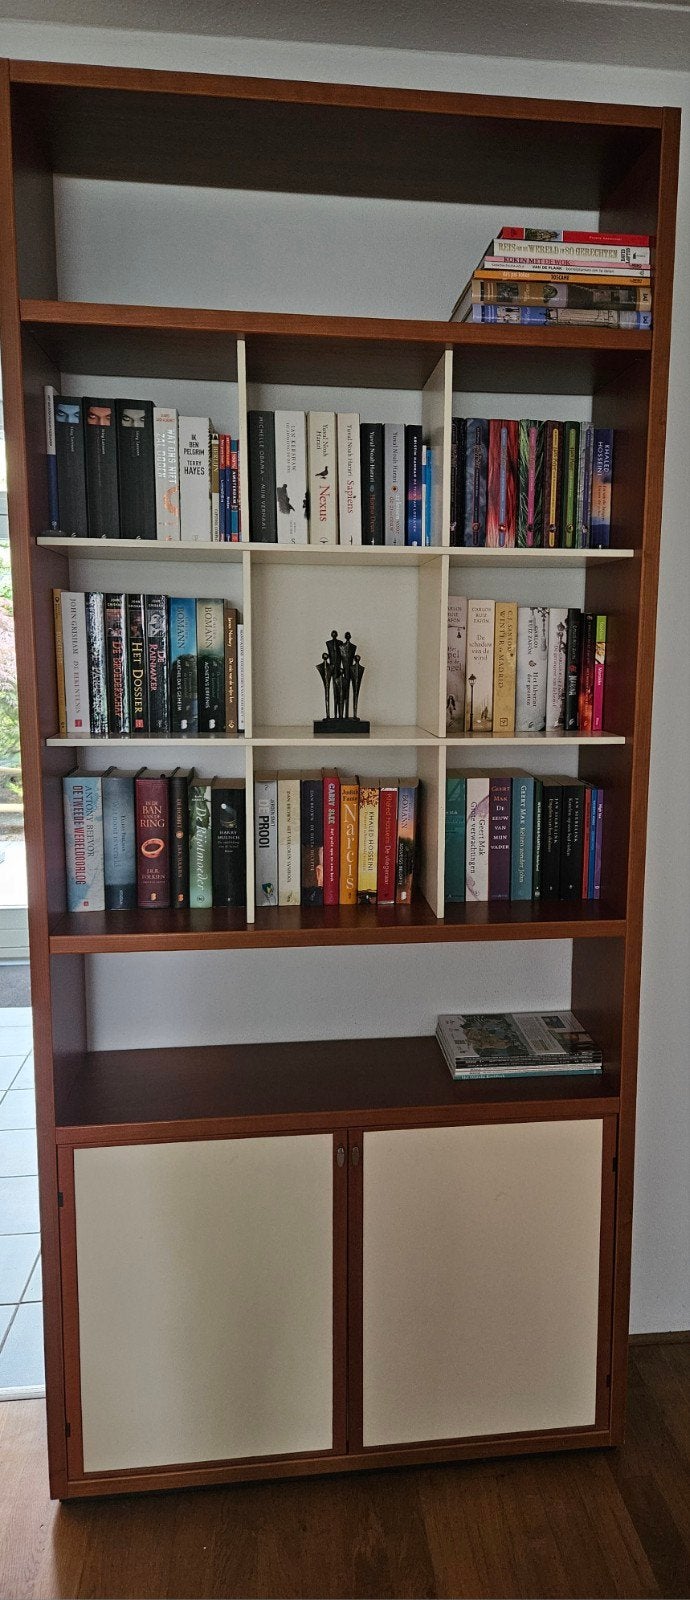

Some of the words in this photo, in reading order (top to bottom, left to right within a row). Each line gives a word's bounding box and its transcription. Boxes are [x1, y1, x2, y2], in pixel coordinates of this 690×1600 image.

[528, 244, 559, 255] WERELD
[576, 248, 618, 258] GERECHTEN
[156, 432, 166, 446] ZAL
[167, 430, 176, 445] WAT
[158, 451, 166, 478] DODEN
[168, 447, 176, 463] ONS
[168, 466, 177, 484] NIET
[184, 467, 204, 476] HAYES
[319, 485, 331, 522] Nexus
[346, 480, 356, 514] Sapiens
[176, 606, 185, 650] BOMANN
[204, 606, 212, 649] BOMANN
[112, 641, 122, 654] DE
[149, 644, 158, 692] RAINMAKER
[72, 786, 83, 794] DE
[73, 796, 84, 824] TWEEDE
[85, 786, 94, 822] ANTONY
[142, 806, 162, 815] BAN
[196, 806, 207, 822] De
[259, 799, 268, 813] DE
[140, 819, 165, 828] RING
[259, 816, 270, 848] PROOI
[86, 825, 94, 858] BEEVOR
[344, 803, 357, 890] Narcis
[386, 846, 391, 854] De
[468, 825, 478, 874] verwachtingen
[74, 827, 86, 885] WERELDOORLOG
[194, 825, 208, 890] Rijstmoeder
